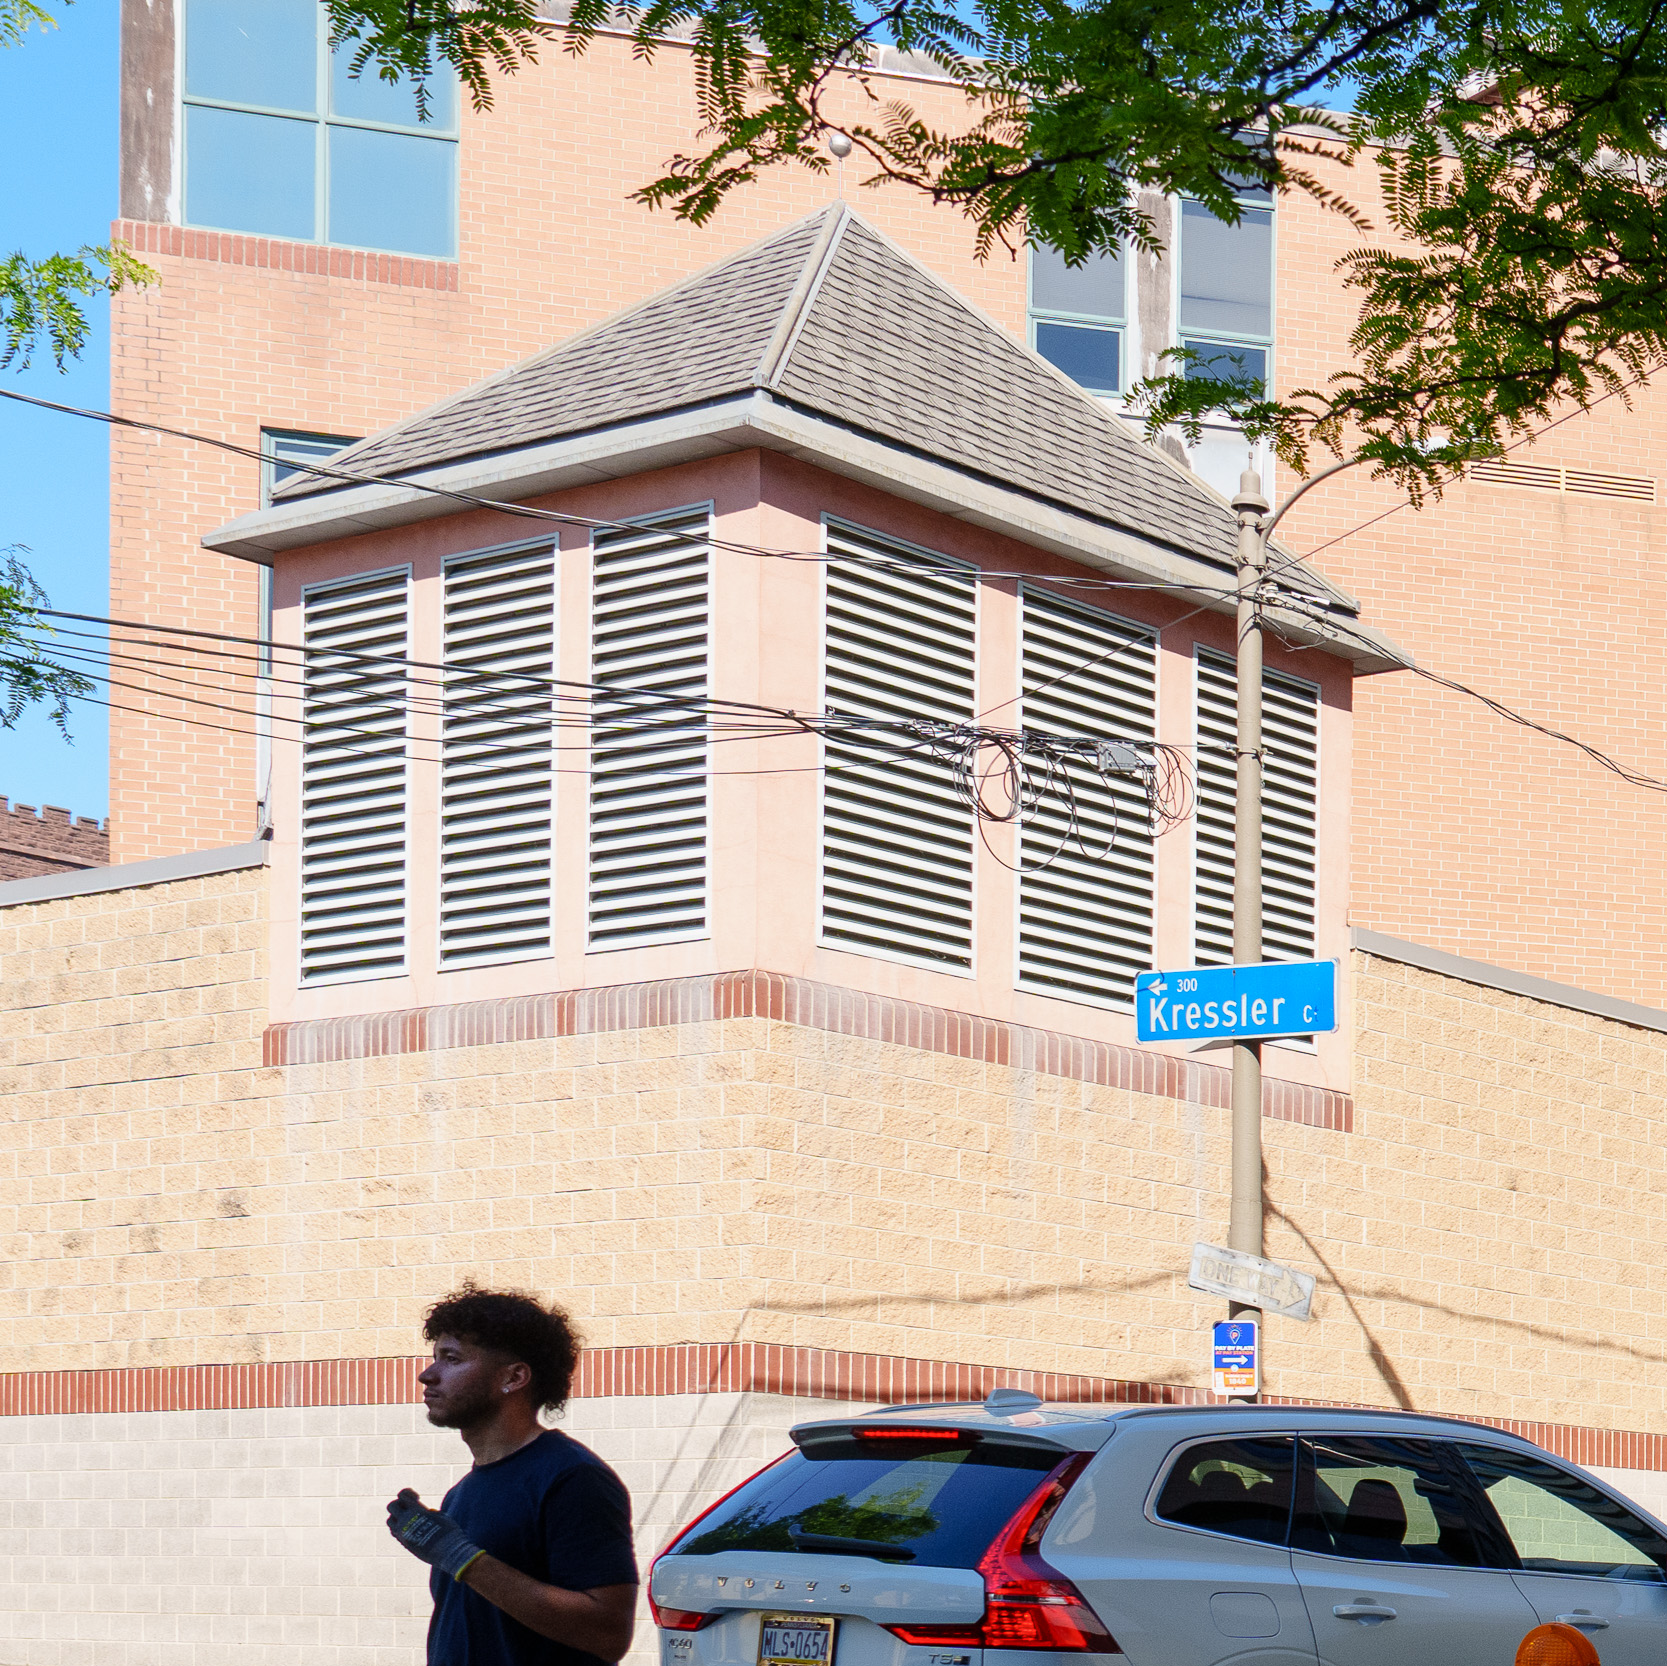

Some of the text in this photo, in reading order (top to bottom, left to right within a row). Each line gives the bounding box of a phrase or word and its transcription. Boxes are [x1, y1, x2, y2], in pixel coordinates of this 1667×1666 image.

[1176, 978, 1198, 993] 300
[1150, 993, 1286, 1033] Kressler
[1202, 1259, 1279, 1296] ONE WAY
[717, 1576, 851, 1593] VOLVO
